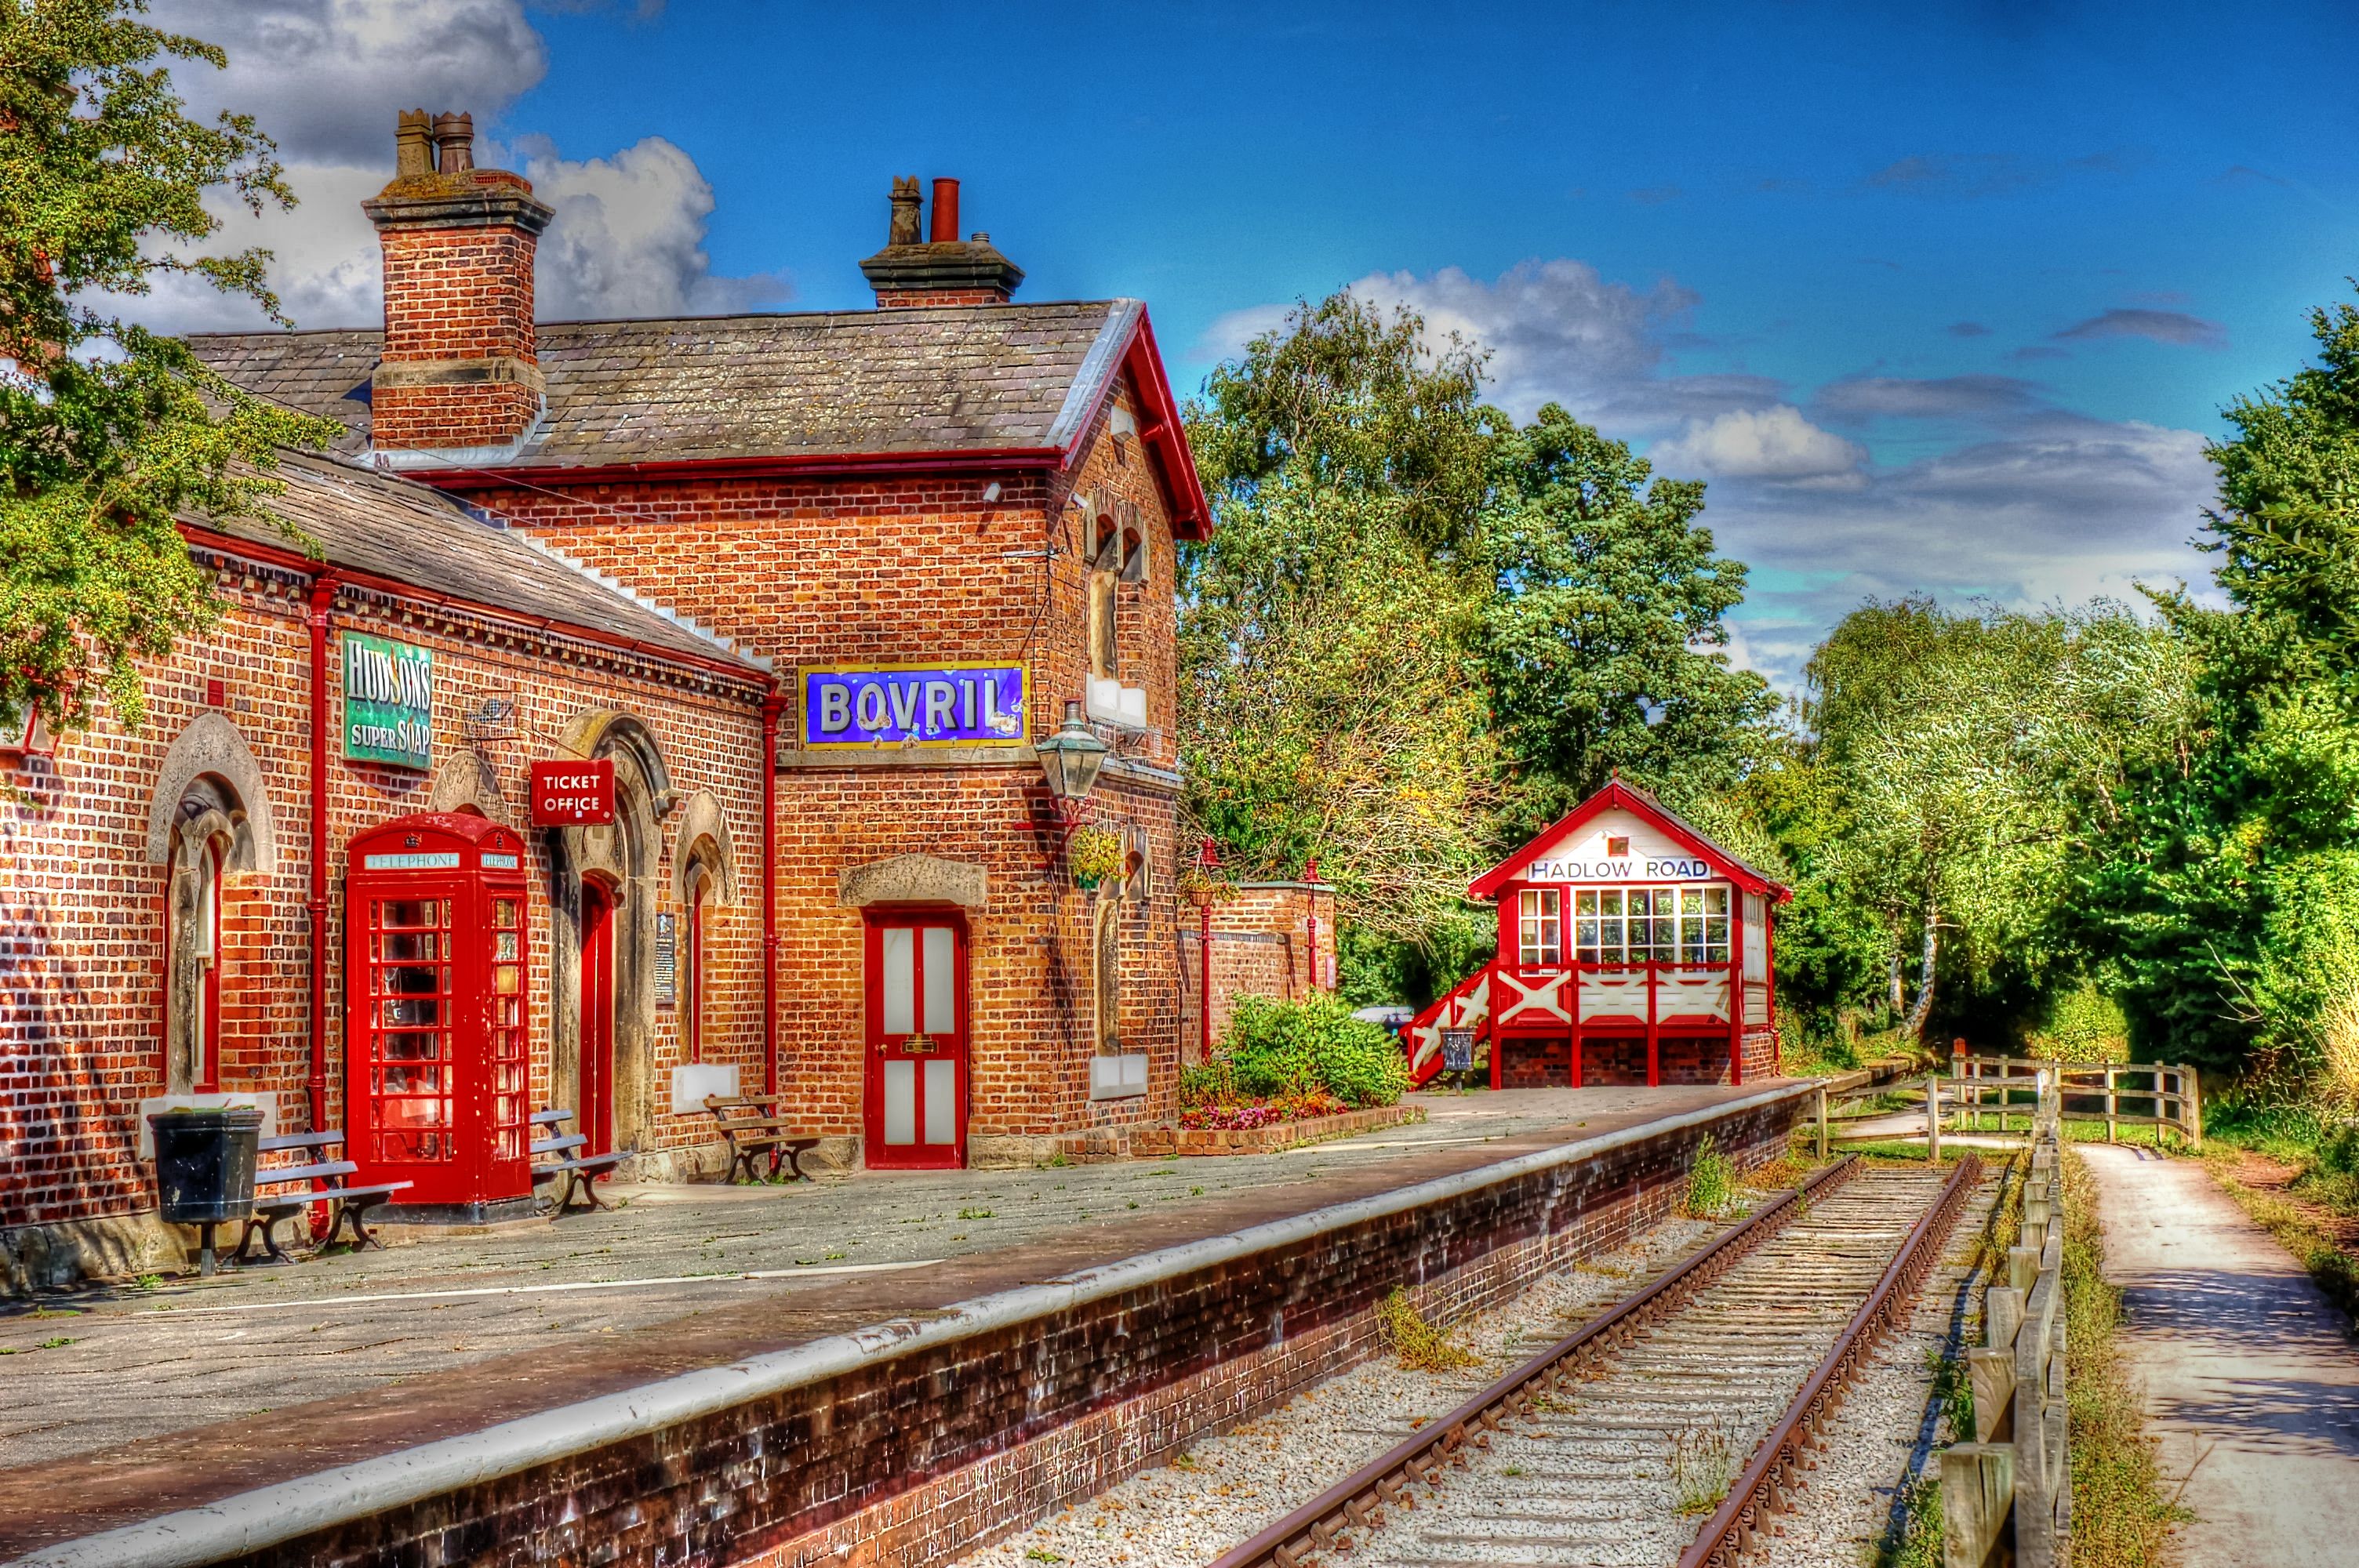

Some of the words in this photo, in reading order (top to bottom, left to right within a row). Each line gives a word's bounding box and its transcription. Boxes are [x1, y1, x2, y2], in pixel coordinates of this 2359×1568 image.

[820, 679, 1018, 731] BOVRIL
[351, 724, 396, 750] SUPER
[398, 720, 429, 756] SOAP
[543, 775, 600, 789] TICKET
[544, 797, 599, 811] OFFICE
[367, 855, 456, 868] TELEPHONE
[482, 855, 515, 867] TELEPHONE
[1532, 862, 1632, 878] HADLOW
[1646, 861, 1707, 877] ROAD
